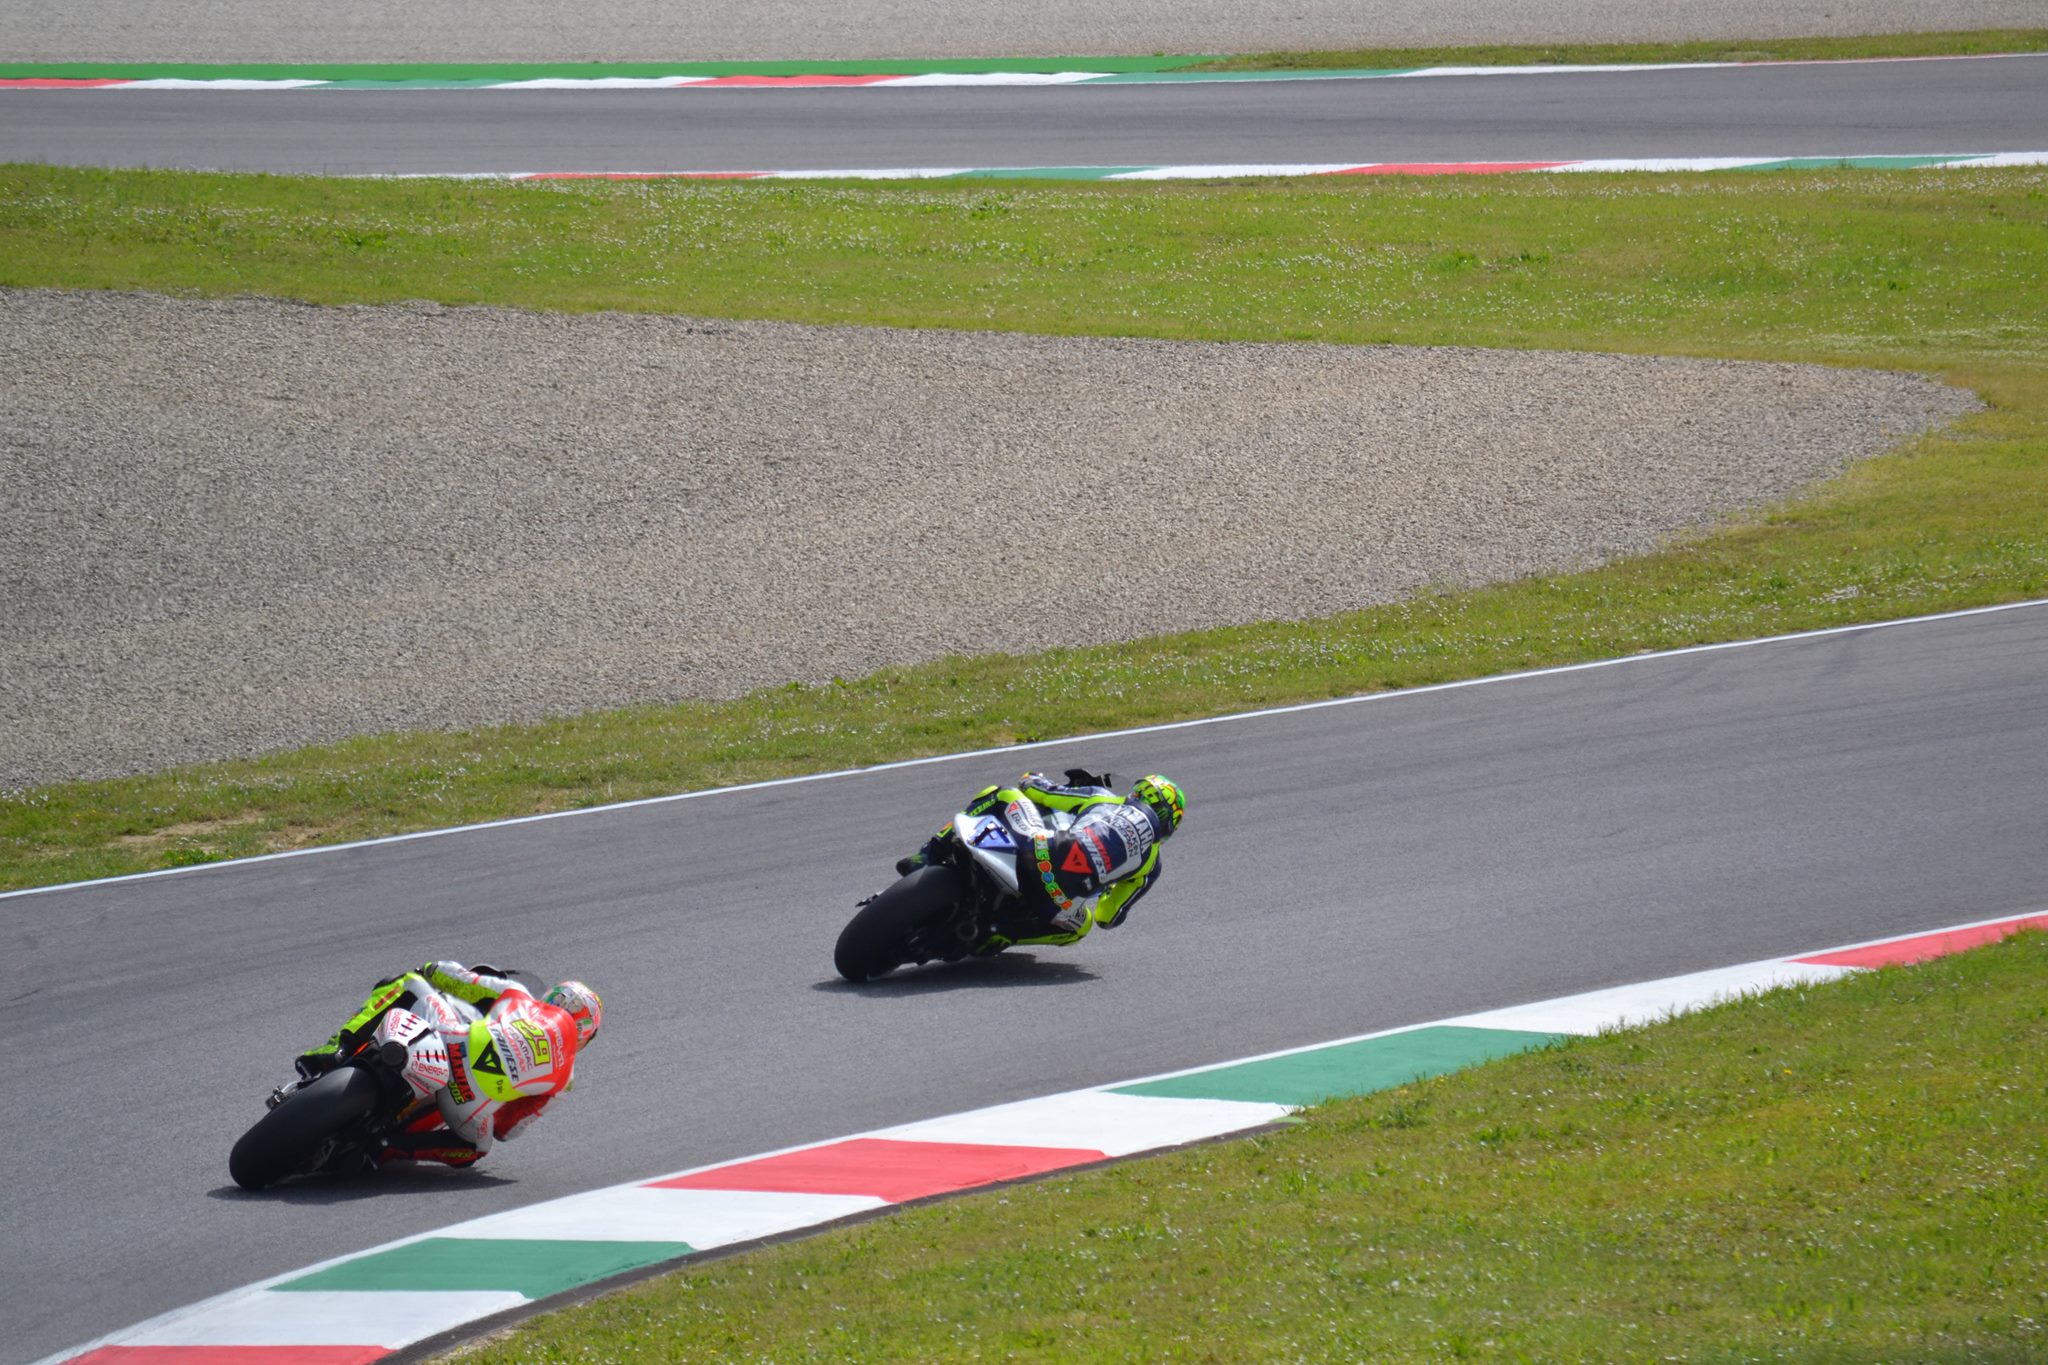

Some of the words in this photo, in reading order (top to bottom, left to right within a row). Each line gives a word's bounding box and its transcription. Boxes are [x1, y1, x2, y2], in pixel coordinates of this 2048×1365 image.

[1037, 860, 1073, 911] DOCTOR
[490, 1028, 519, 1081] DAINESE
[510, 1018, 551, 1067] 29
[447, 1043, 476, 1101] MANIAC
[448, 1081, 465, 1105] JOE
